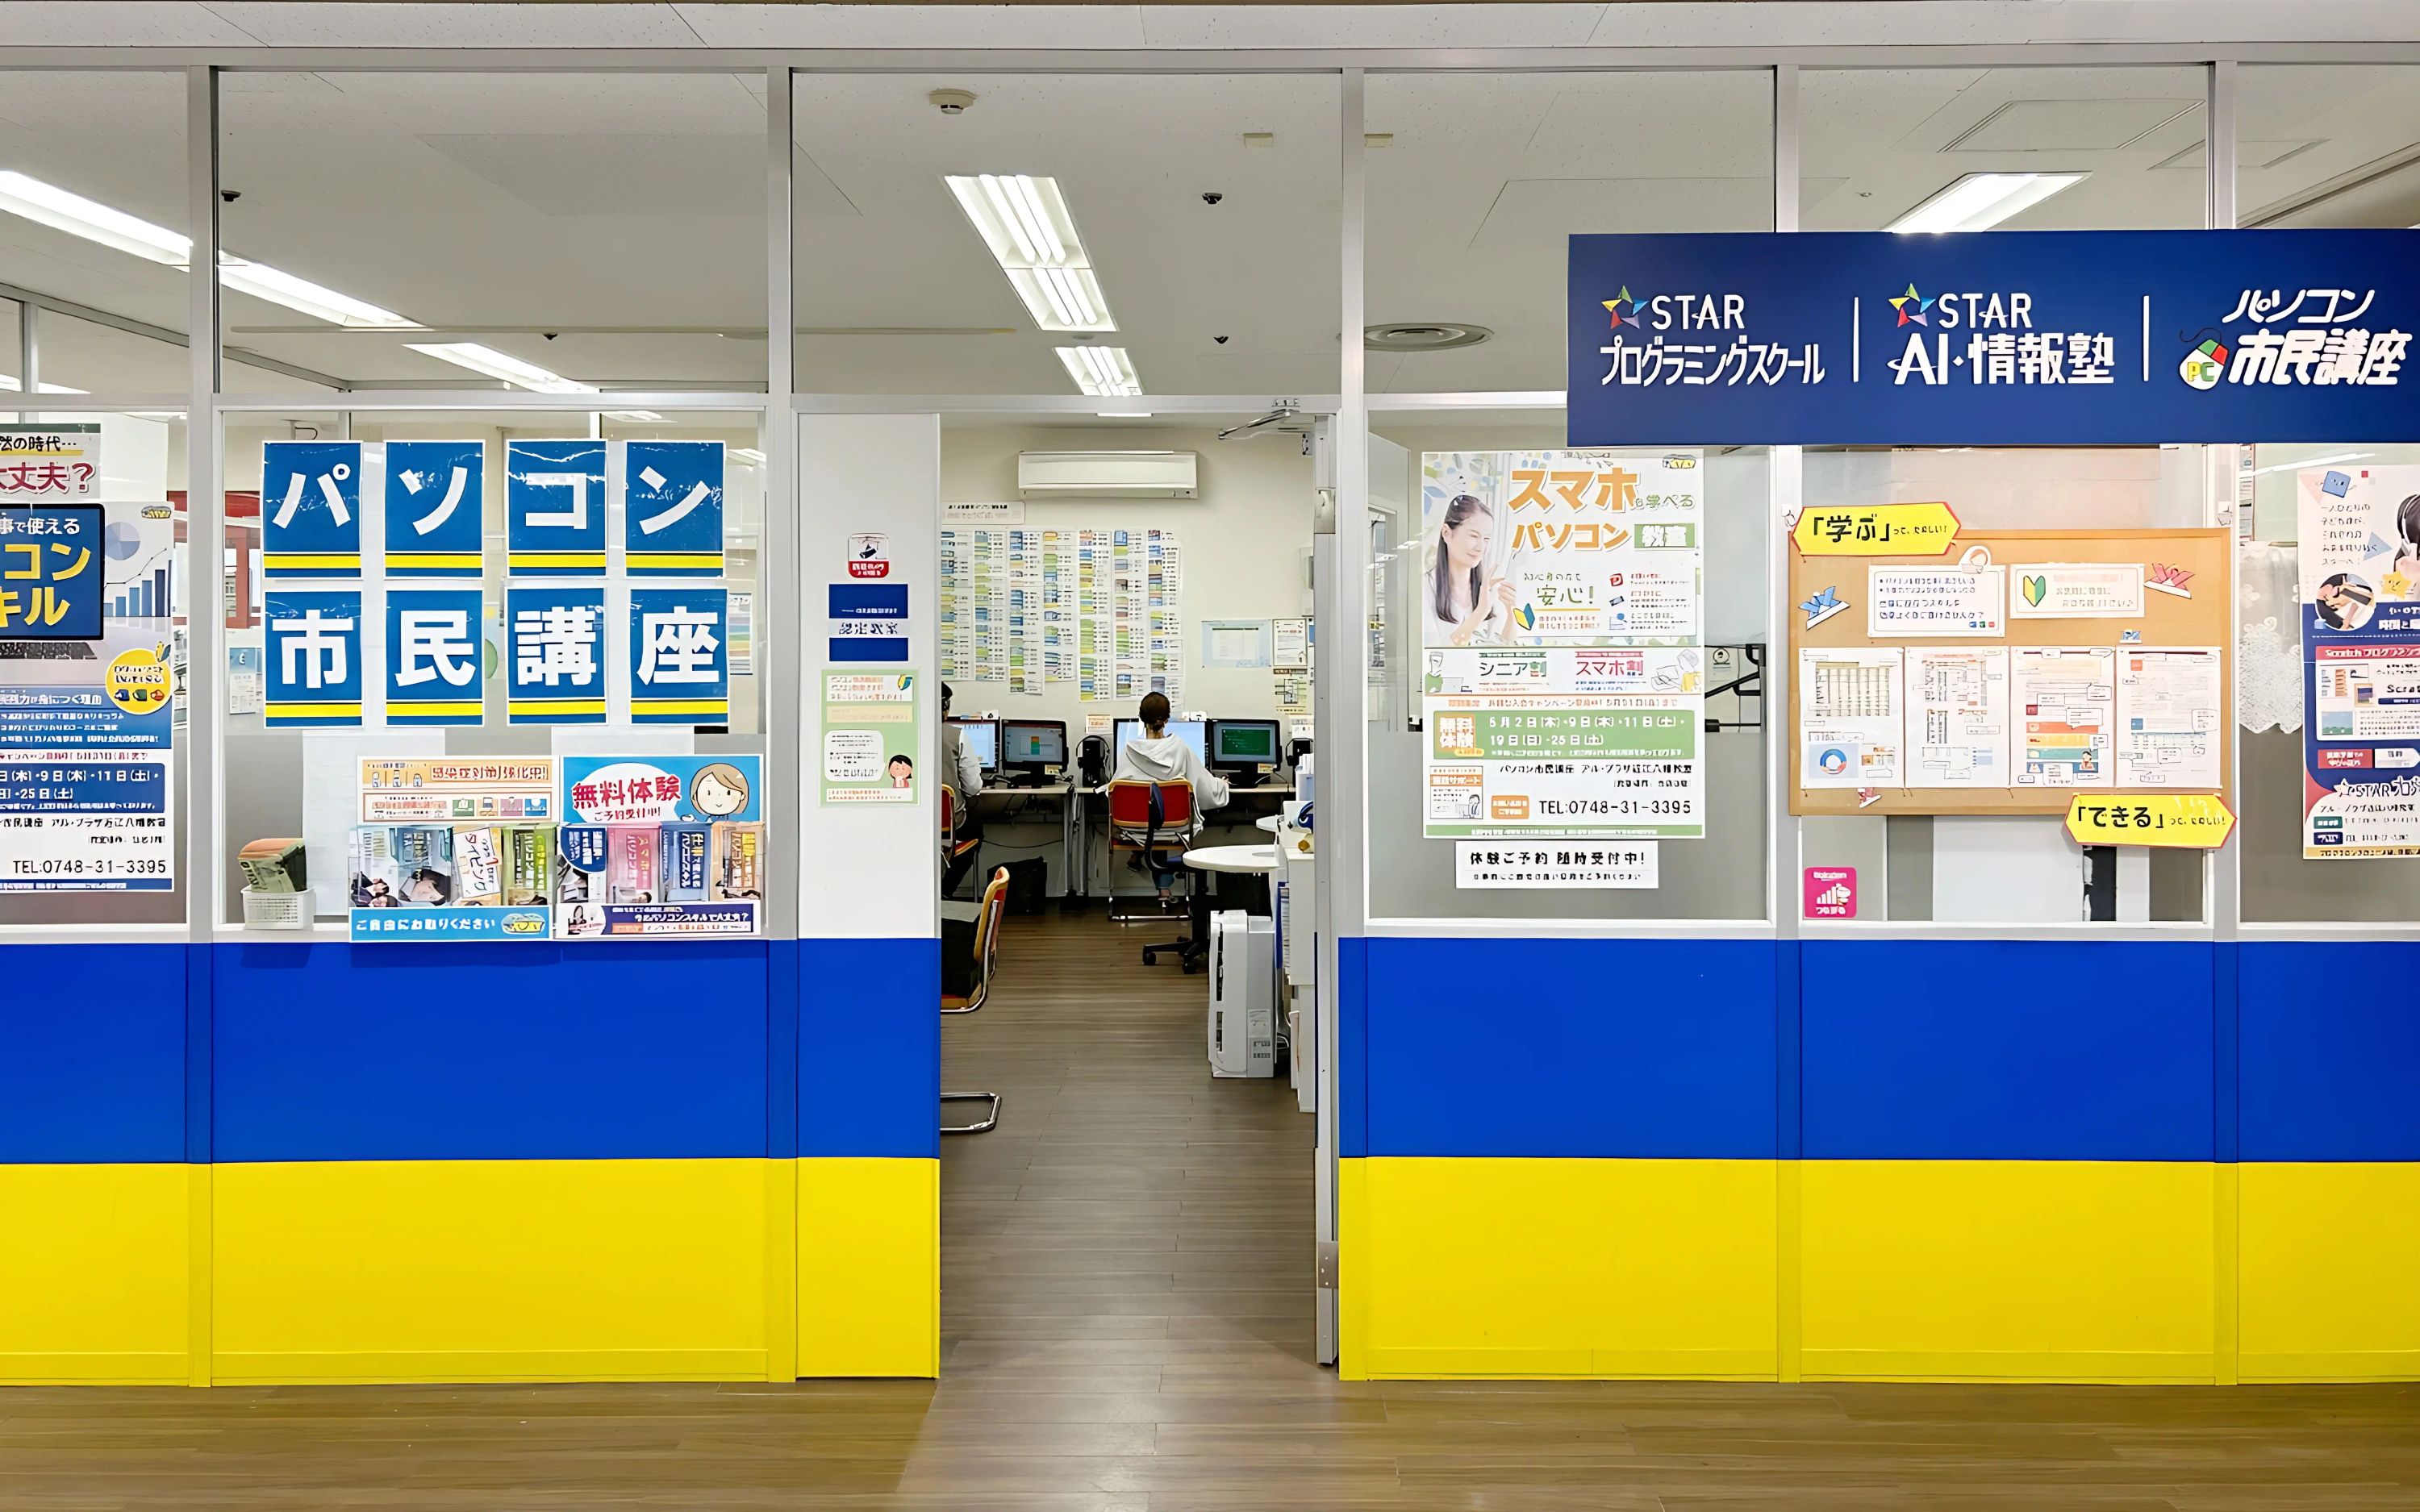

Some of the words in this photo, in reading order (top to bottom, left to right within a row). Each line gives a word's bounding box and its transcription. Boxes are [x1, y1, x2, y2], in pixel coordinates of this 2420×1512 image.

[1651, 294, 1746, 330] STAR
[1939, 293, 2032, 328] STAR
[2222, 289, 2375, 323] パソコン
[1600, 335, 1825, 387] プログラミングスクール
[2228, 328, 2413, 386] 市民講座
[0, 462, 94, 491] 丈夫?
[1512, 522, 1629, 550] パソコン
[4, 542, 91, 581] コン
[572, 775, 682, 810] 無料体験
[13, 860, 166, 873] TEL:0748-31-3395
